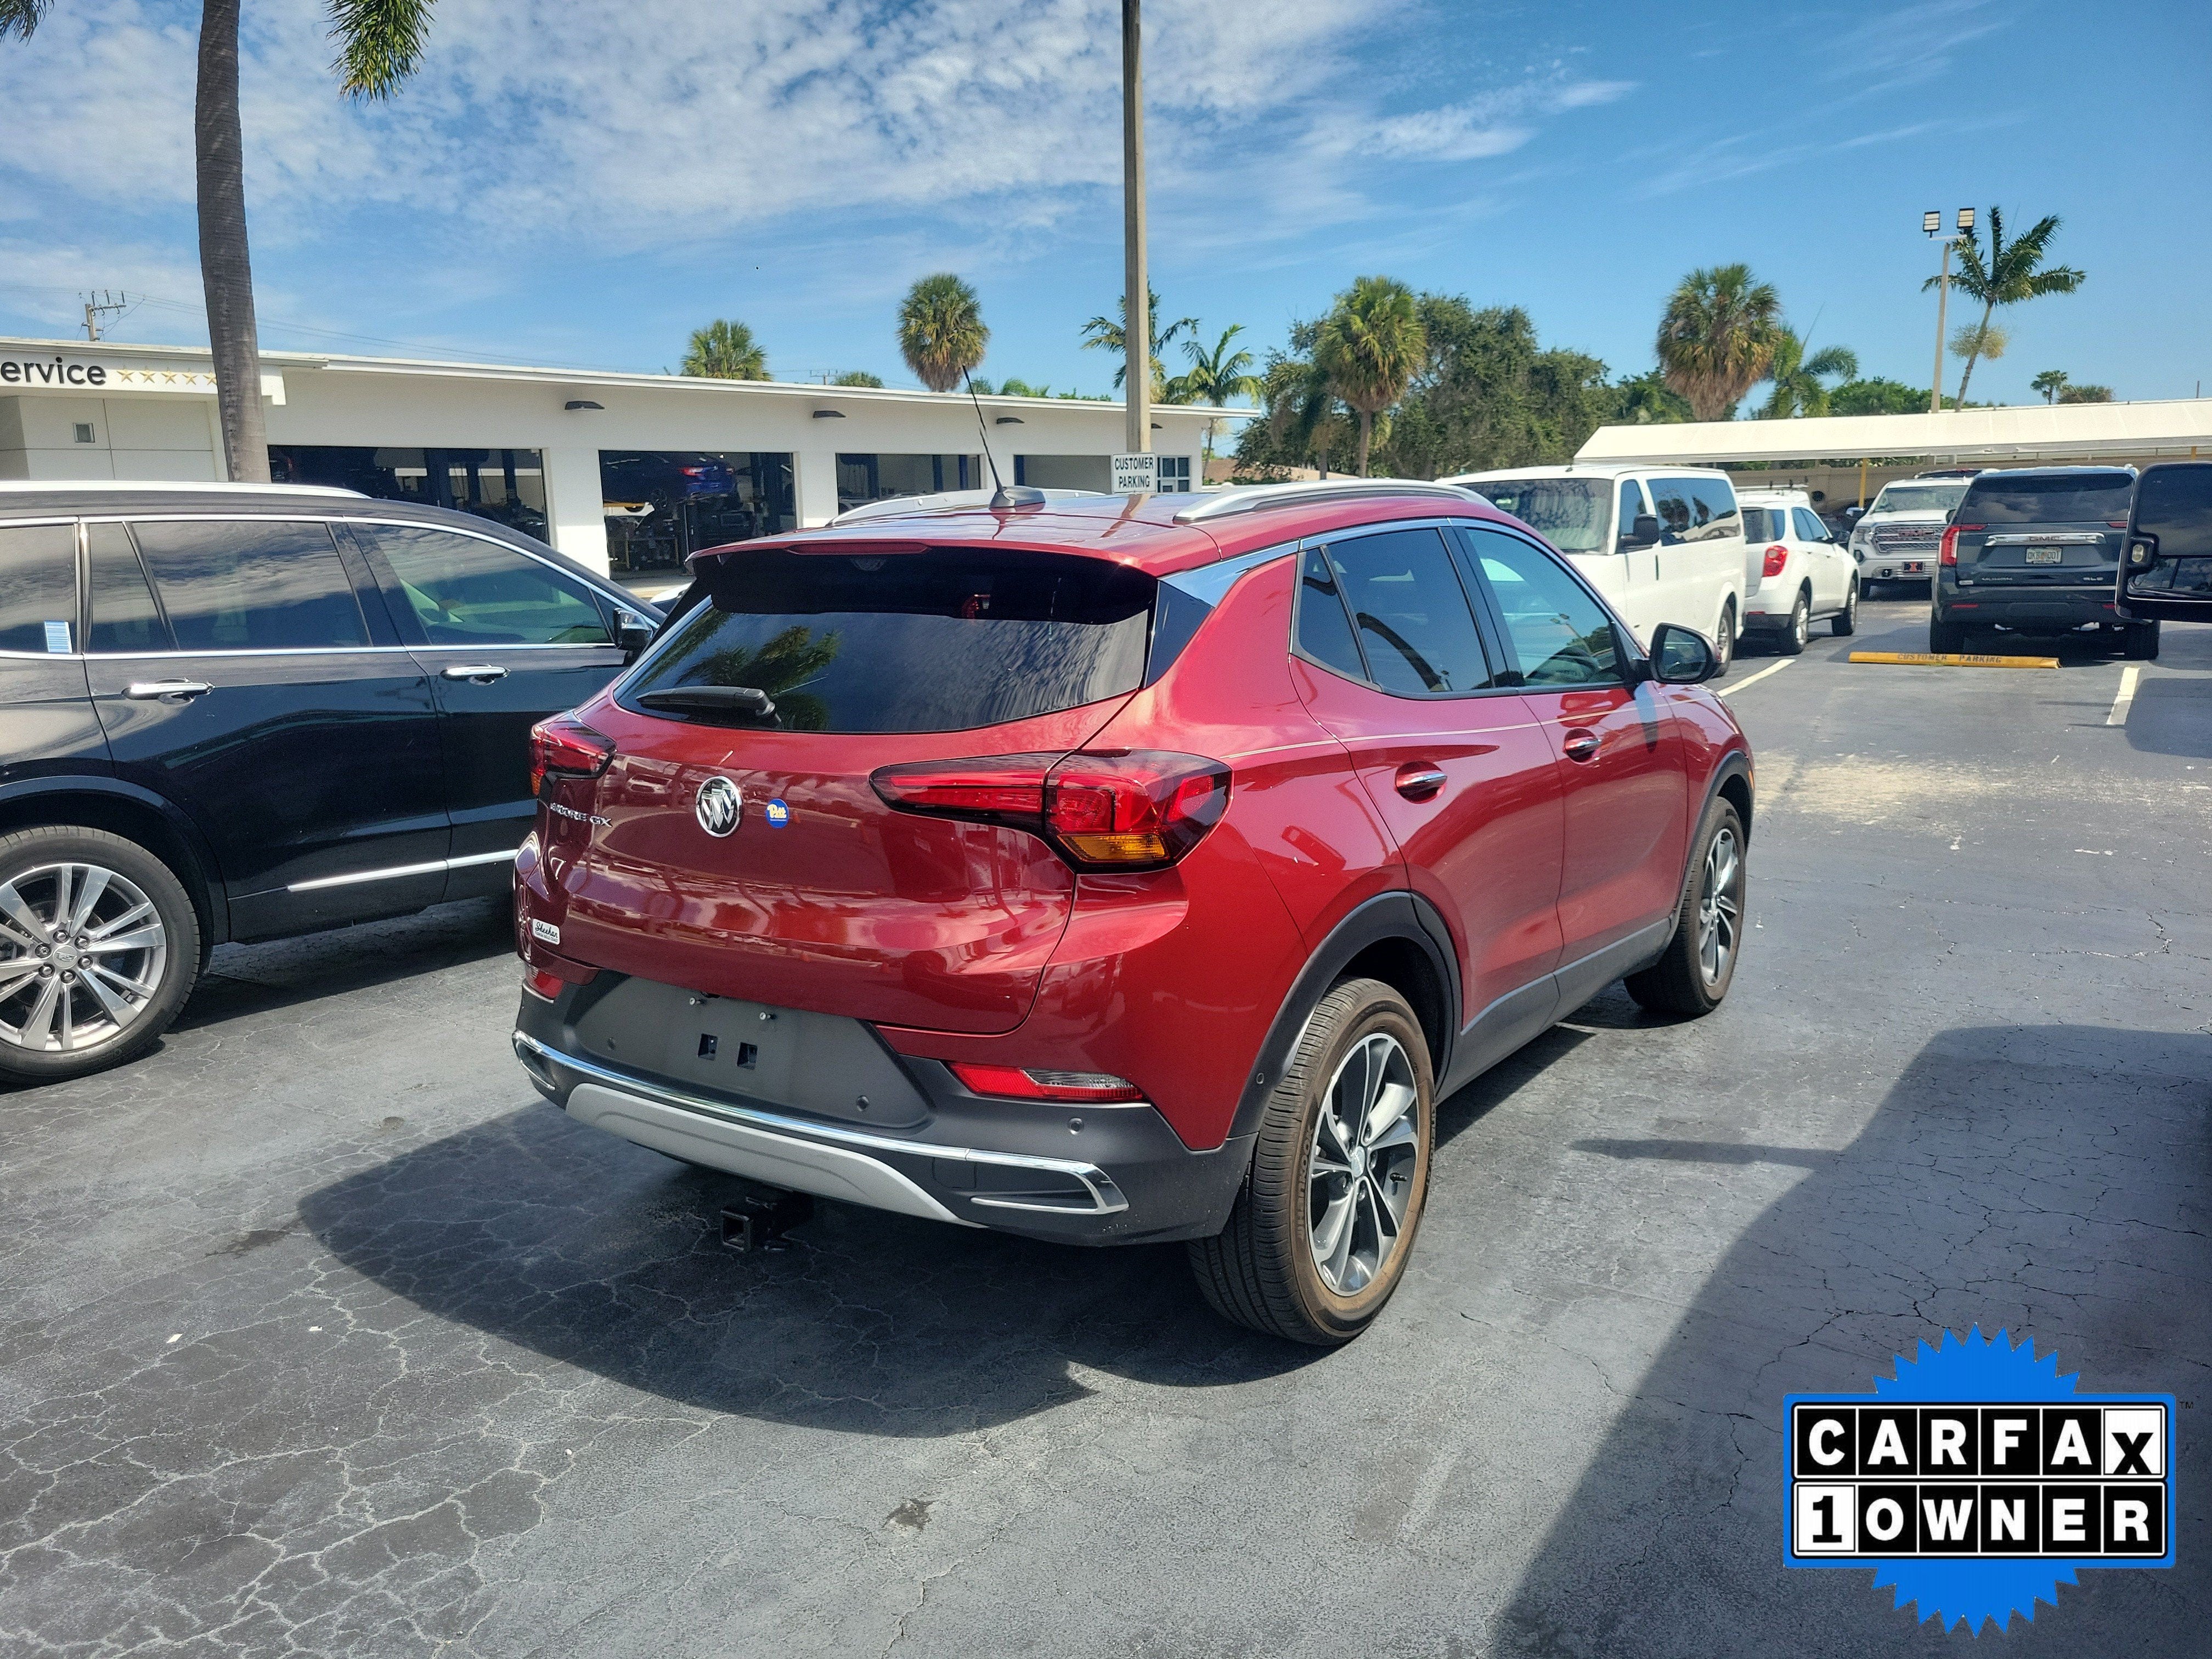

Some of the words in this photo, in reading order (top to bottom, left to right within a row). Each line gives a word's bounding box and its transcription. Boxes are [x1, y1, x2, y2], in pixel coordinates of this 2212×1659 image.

[1, 357, 106, 386] ervice
[1115, 457, 1154, 470] CUSTOMER
[1119, 475, 1150, 488] PARKING
[1897, 653, 1948, 662] CUSTOMER
[1958, 654, 2001, 663] PARKING
[550, 802, 589, 822] ENCORE
[590, 815, 613, 828] GX
[535, 922, 558, 939] Sheehan
